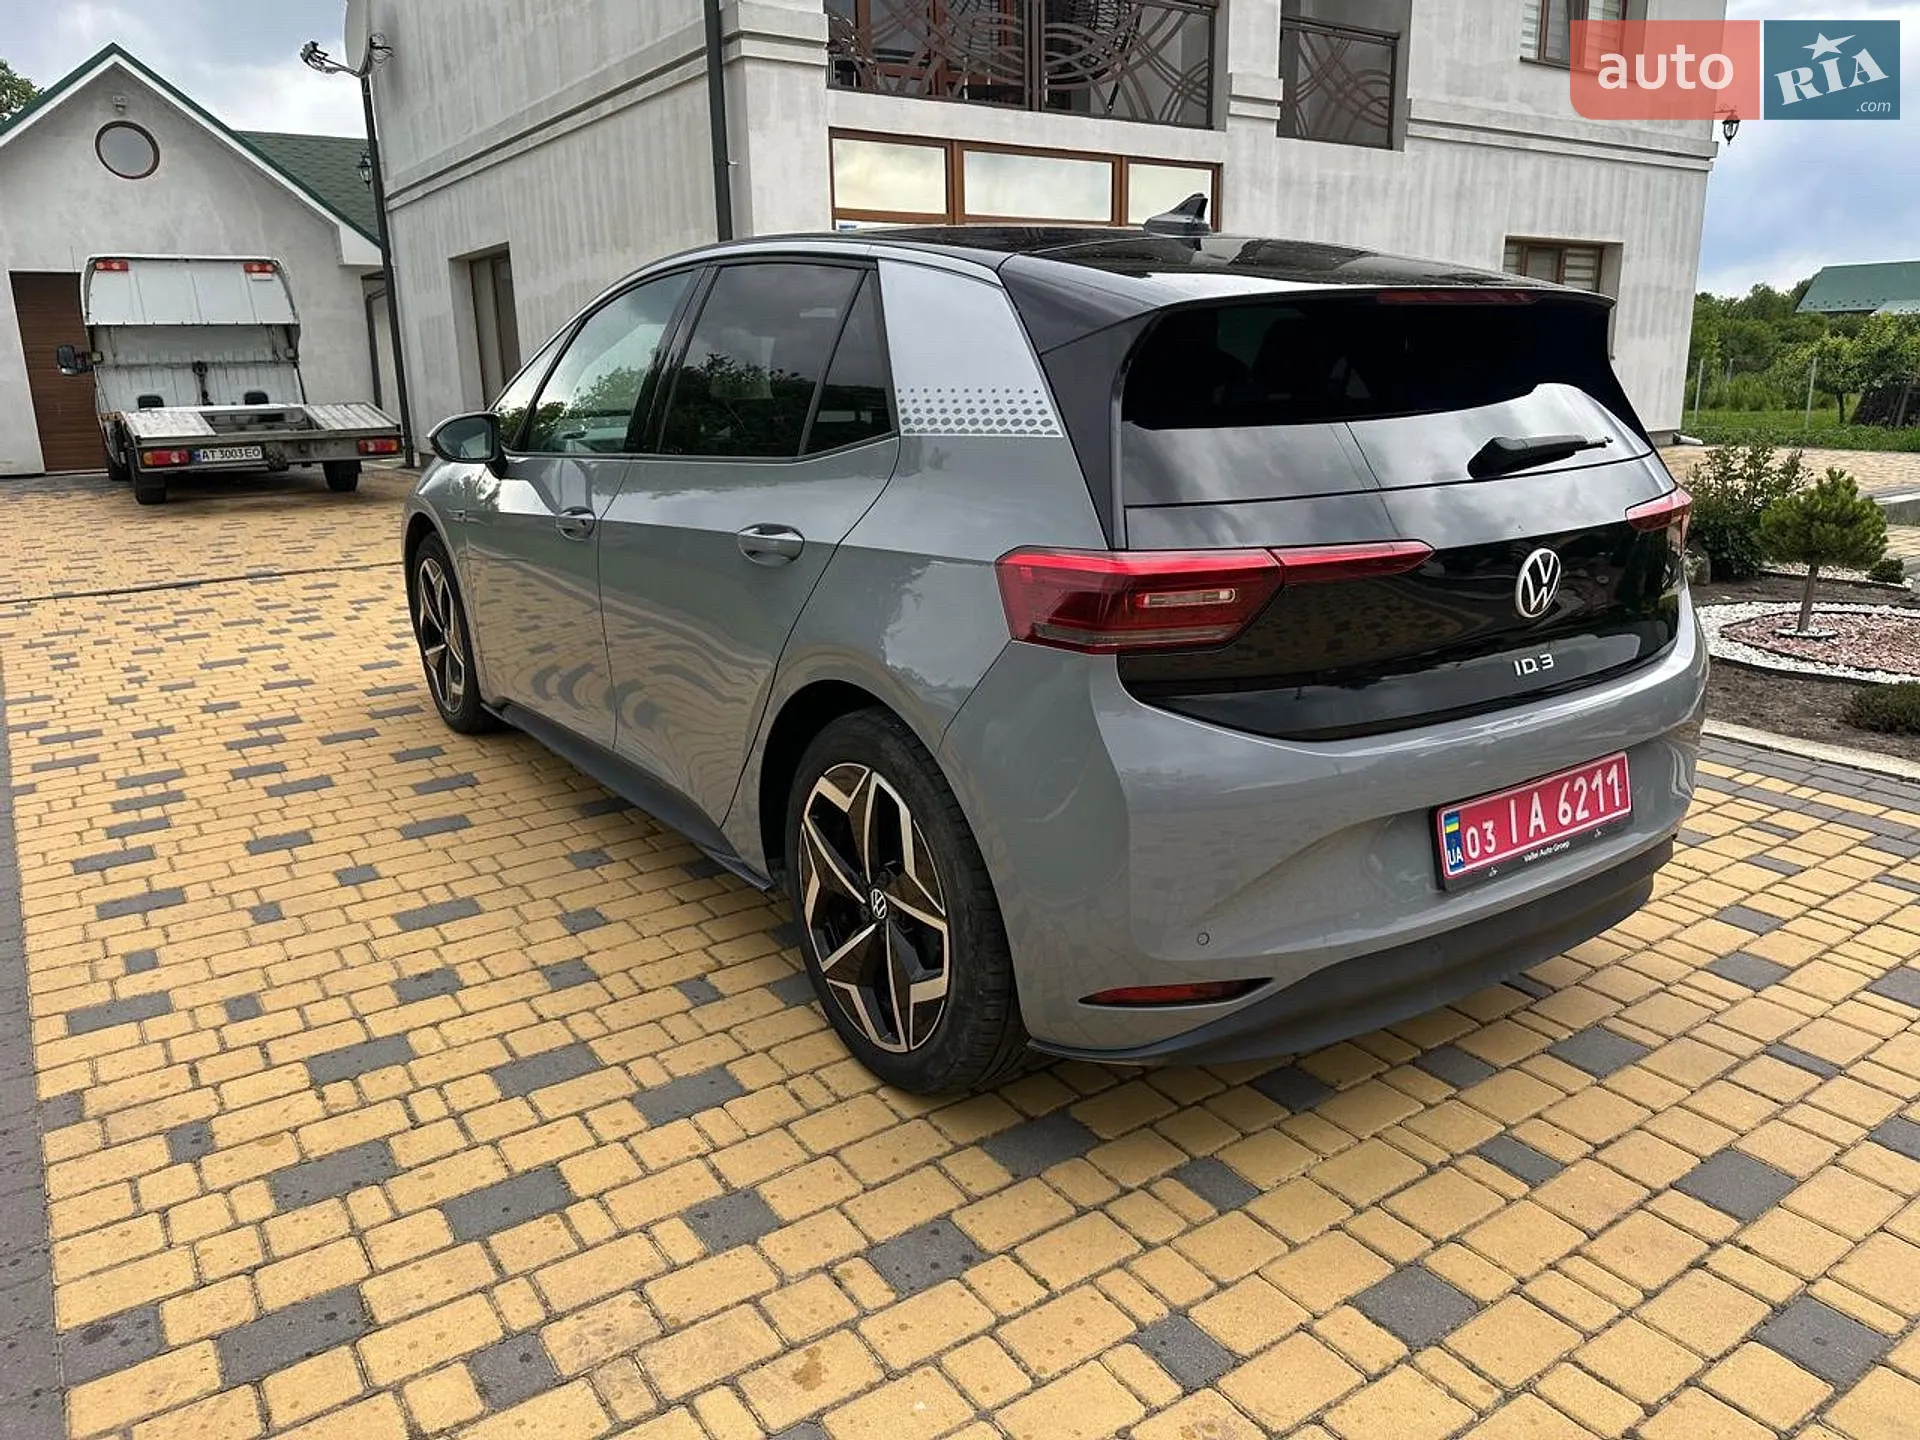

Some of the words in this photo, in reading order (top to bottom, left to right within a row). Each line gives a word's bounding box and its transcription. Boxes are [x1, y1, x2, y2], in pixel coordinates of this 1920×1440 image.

[1466, 820, 1497, 859] 03
[1557, 764, 1620, 826] 6211
[1447, 846, 1464, 865] UA
